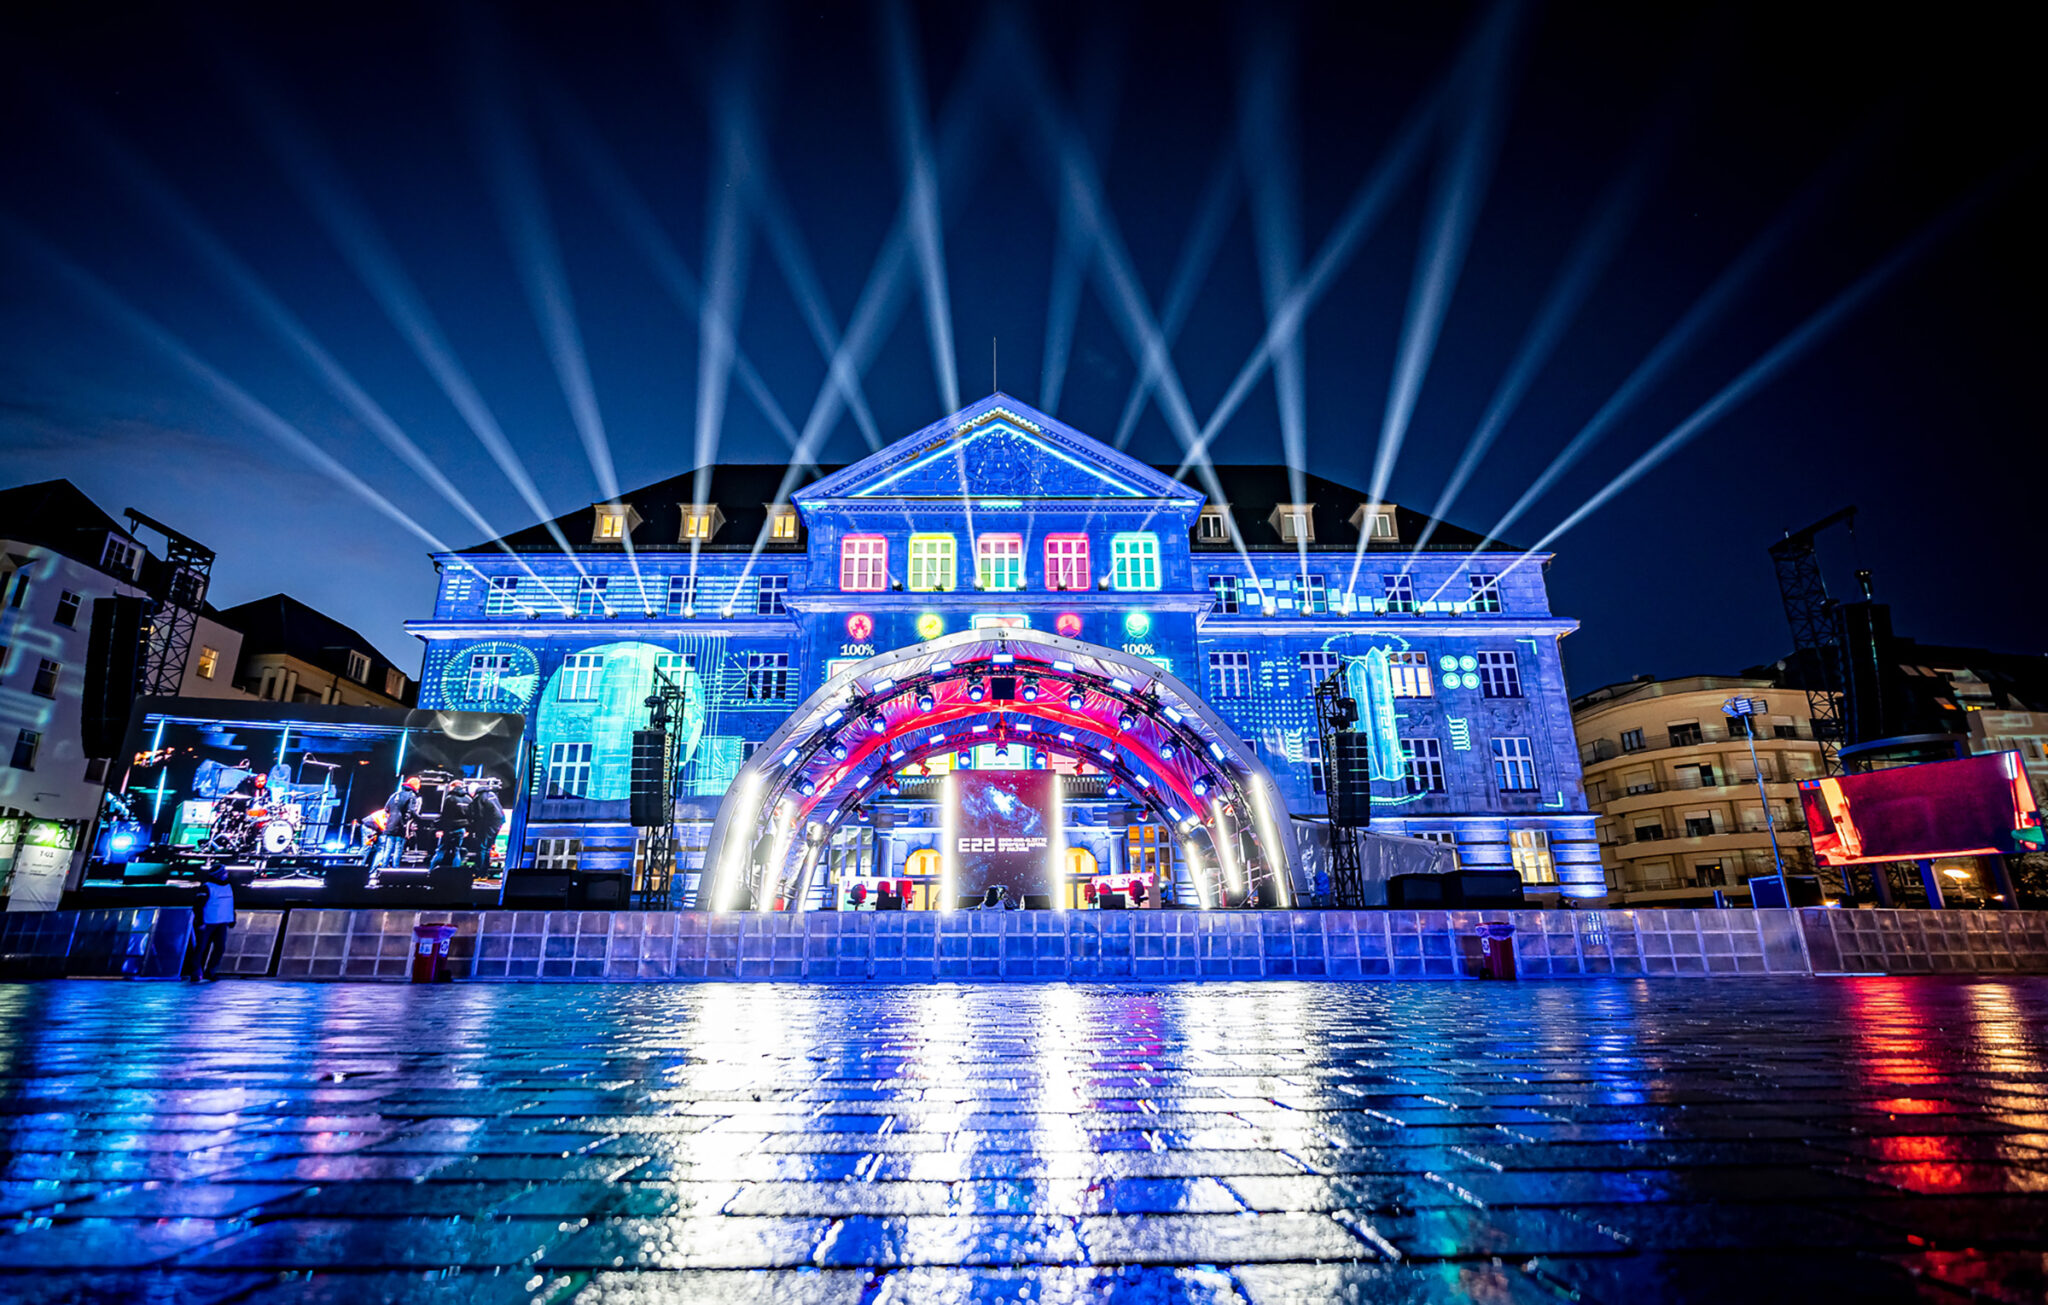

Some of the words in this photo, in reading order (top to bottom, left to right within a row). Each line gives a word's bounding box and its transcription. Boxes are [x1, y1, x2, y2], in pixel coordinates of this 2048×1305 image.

[840, 644, 875, 656] 100%
[1121, 643, 1155, 656] 100%
[958, 838, 995, 852] E22
